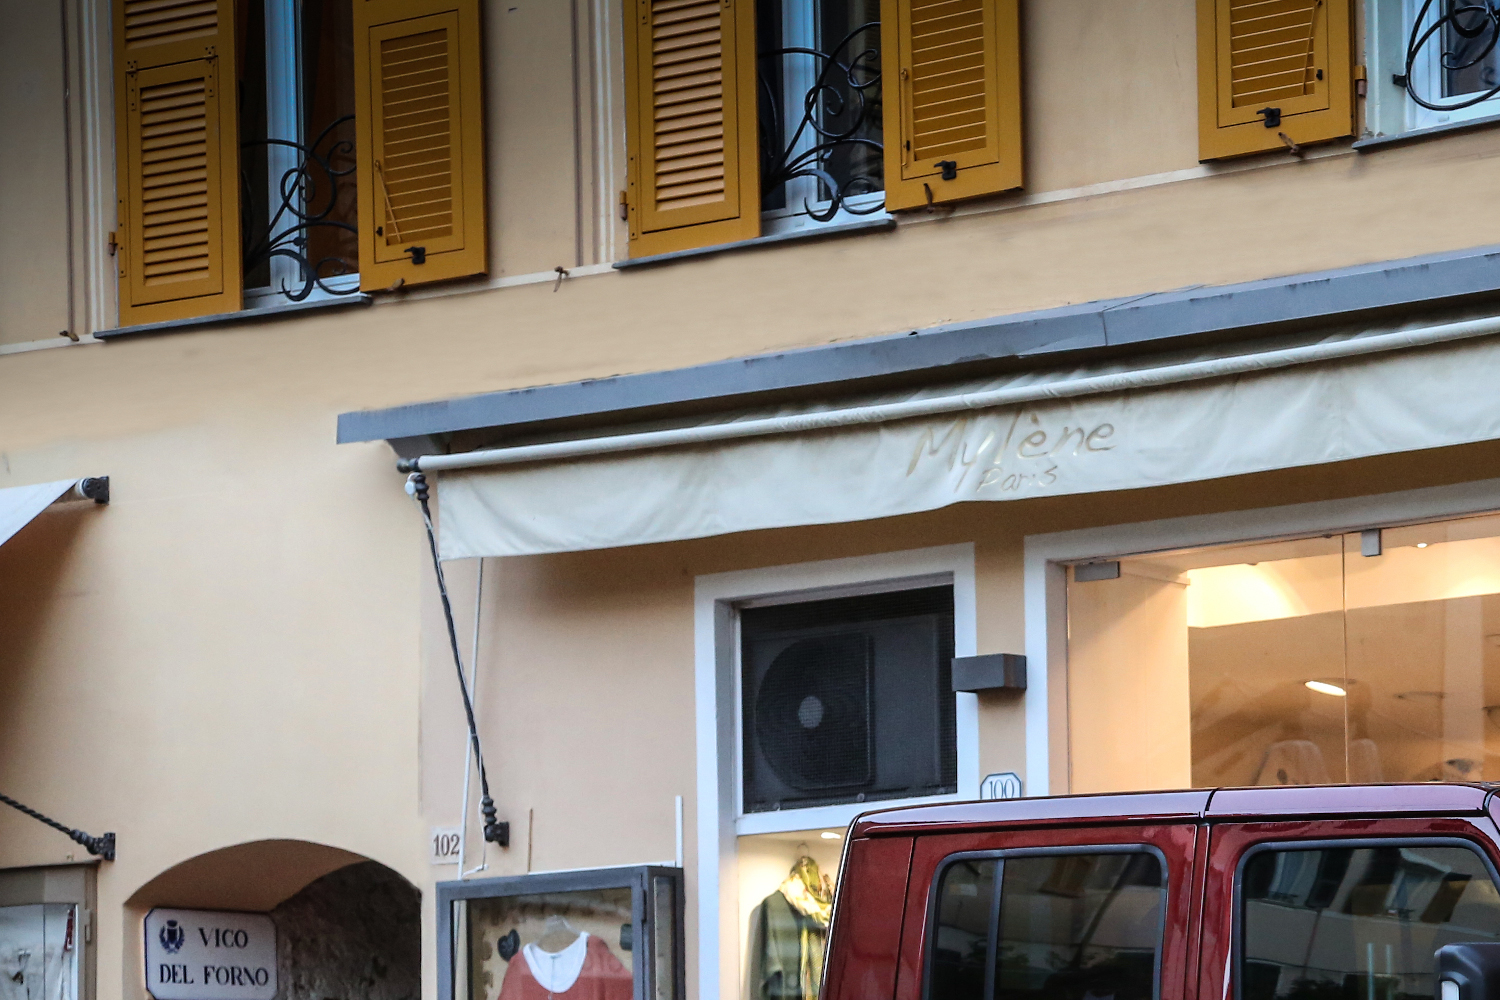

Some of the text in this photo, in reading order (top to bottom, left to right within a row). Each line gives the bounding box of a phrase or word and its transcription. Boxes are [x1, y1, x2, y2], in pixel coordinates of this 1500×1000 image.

[433, 834, 460, 857] 102
[198, 927, 249, 948] VICO
[159, 964, 269, 986] DEL FORNO
